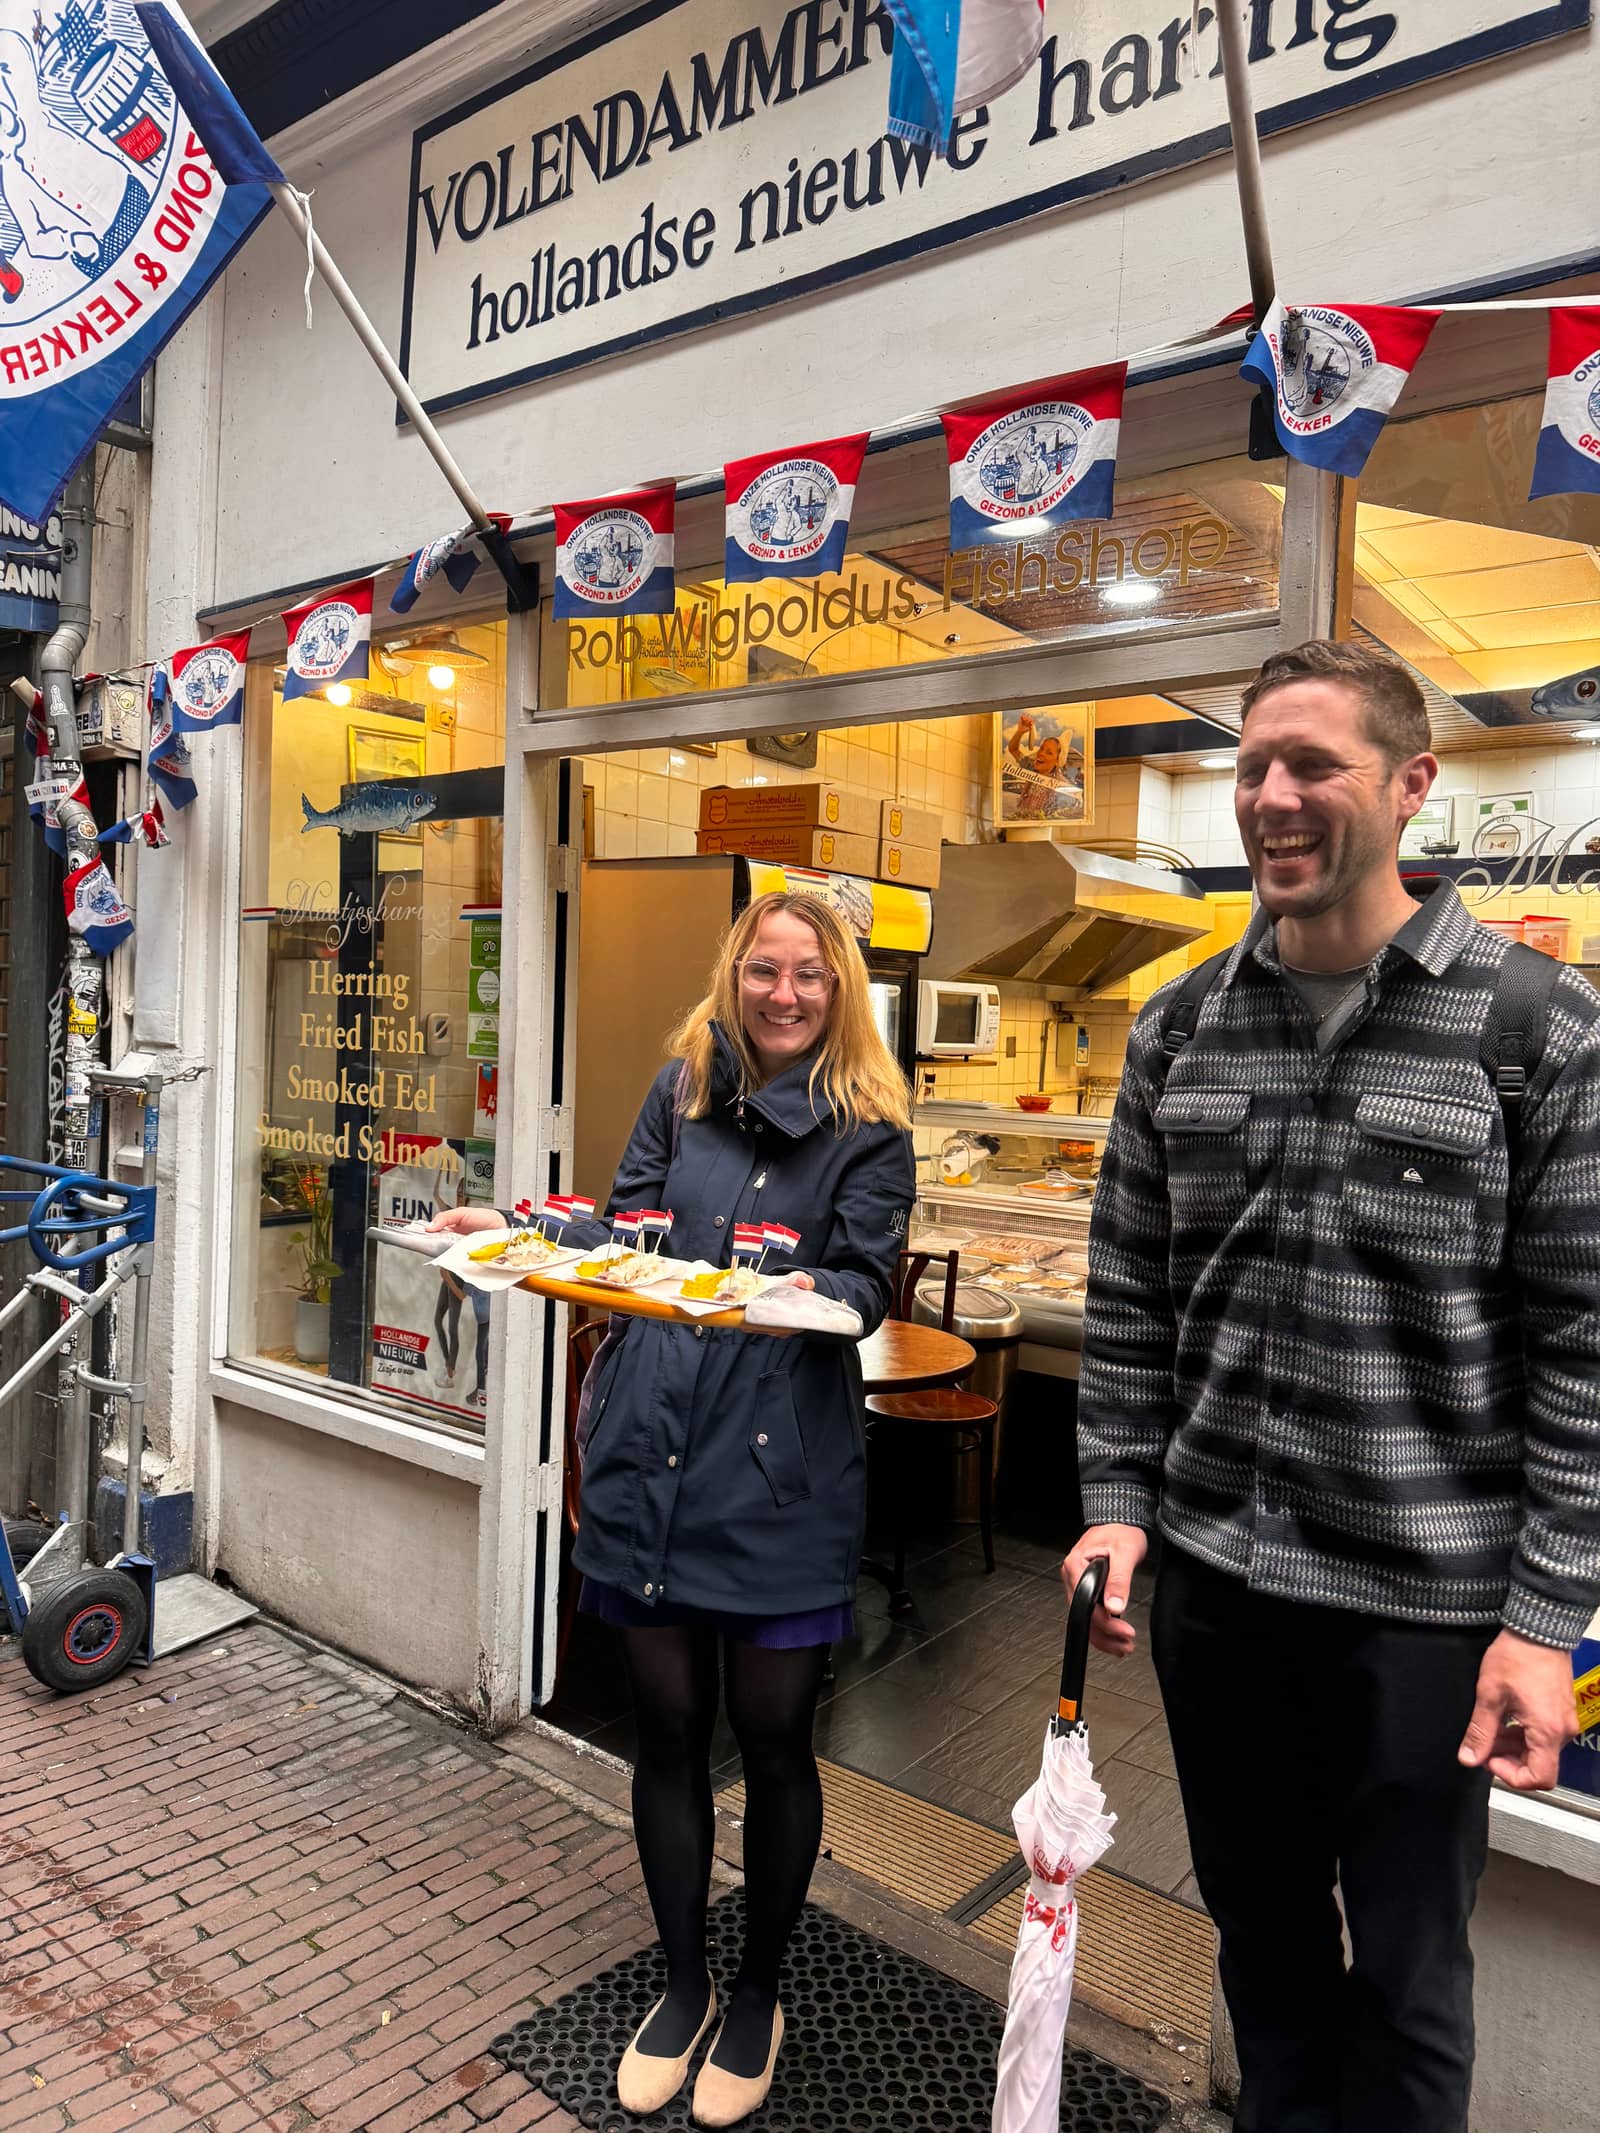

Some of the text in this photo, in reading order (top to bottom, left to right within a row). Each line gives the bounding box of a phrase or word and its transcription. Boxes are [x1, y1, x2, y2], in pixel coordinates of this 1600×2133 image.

[417, 0, 894, 254] VOLENDAMMER
[466, 0, 1398, 350] hollandse nieuwe harng
[1342, 319, 1373, 369] NIEUWE
[967, 403, 1094, 464] ONZE HOLLANDSE NIEUWE
[1282, 410, 1332, 432] LEKKER
[740, 461, 838, 508] ONZE HOLLANDSE NIEUWE
[980, 475, 1076, 519] GEZOND & LEKKER
[566, 510, 653, 550] ONZE HOLLANDSE NIEUWE
[748, 533, 825, 559] GEZOND & LEKKER
[567, 517, 1230, 671] Rob Wigboldus FishShop
[572, 576, 642, 601] GEZOND & LEKKER
[306, 603, 340, 625] HOLLANDSE
[308, 959, 410, 1011] Herring
[298, 1012, 426, 1055] Fried Fish
[286, 1064, 437, 1114] Smoked Eel
[257, 1112, 460, 1173] Smoked Salmon
[392, 1196, 433, 1223] FIJN
[379, 1343, 419, 1365] NIEUWE
[380, 1328, 421, 1347] HOLLANDSE
